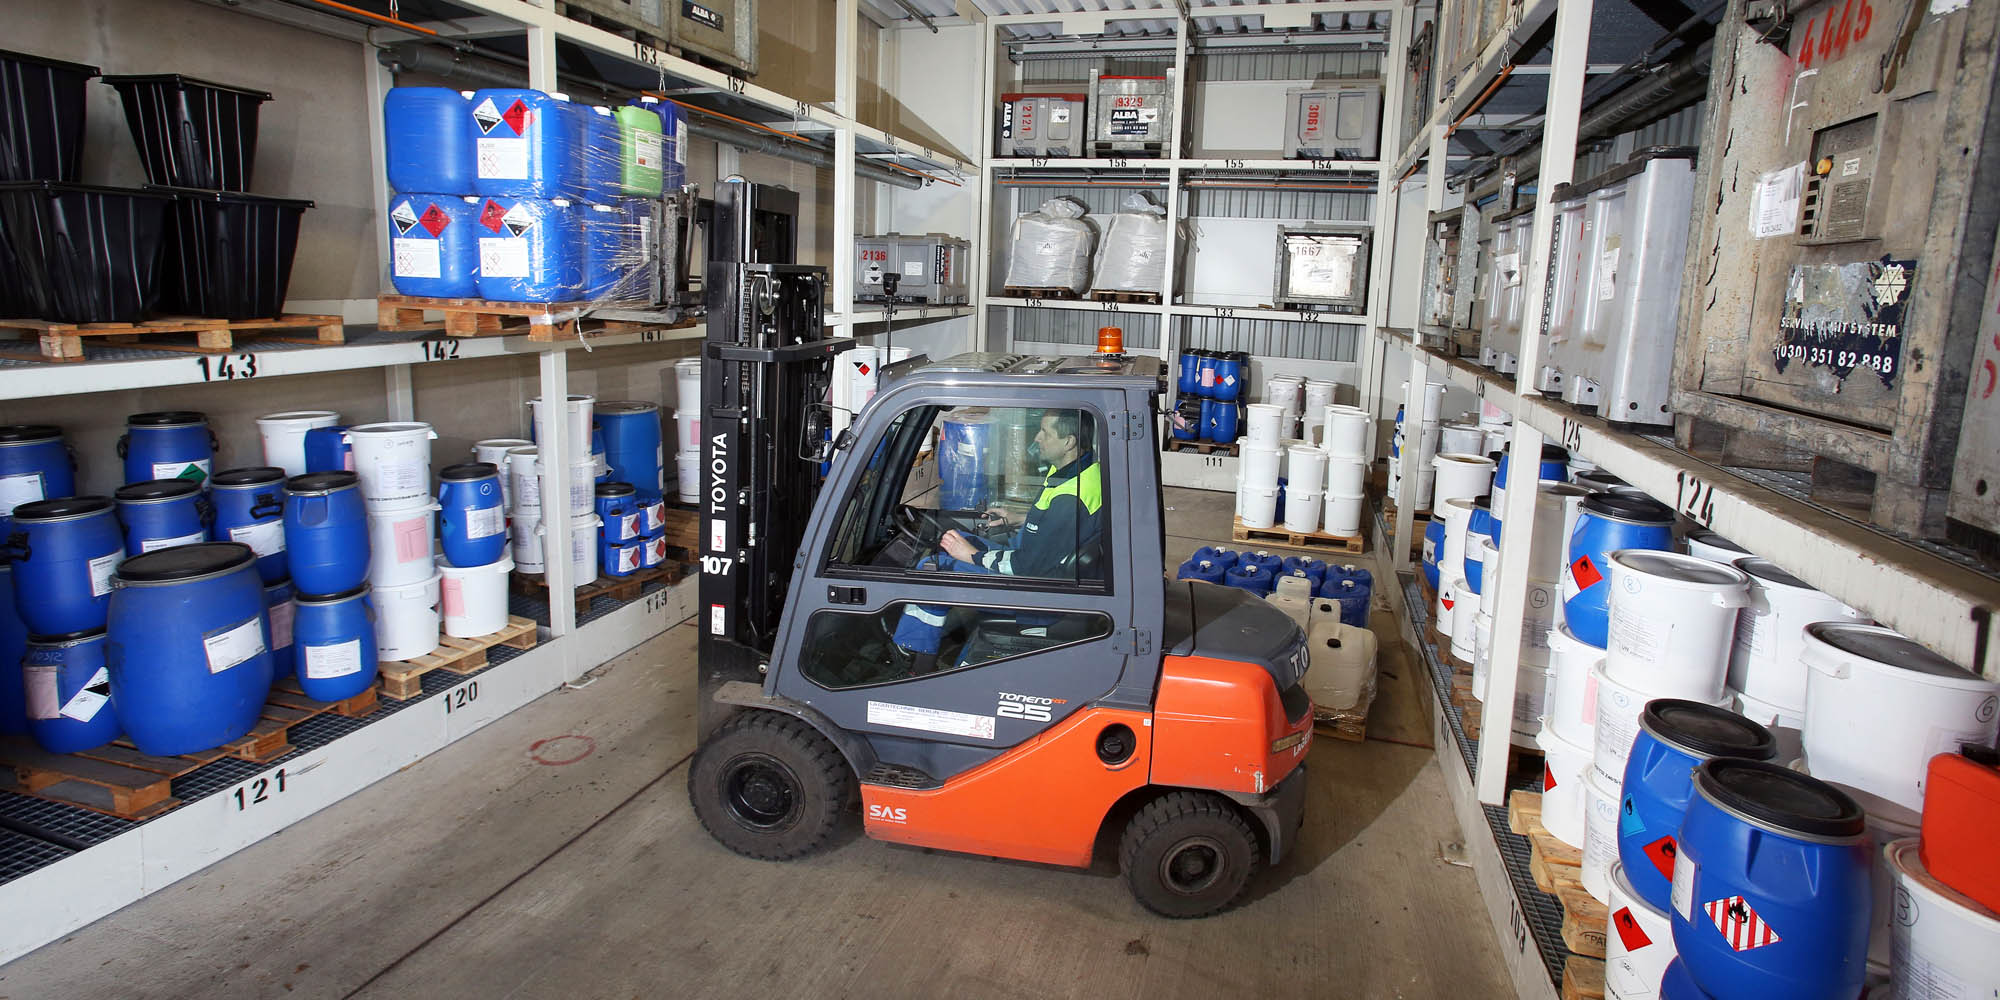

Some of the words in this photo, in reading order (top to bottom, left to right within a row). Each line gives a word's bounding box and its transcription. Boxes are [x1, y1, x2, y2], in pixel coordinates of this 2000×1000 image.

[633, 43, 657, 64] 163
[727, 75, 745, 94] 162
[1002, 102, 1012, 128] ALBA
[1022, 104, 1033, 132] 2121
[1112, 111, 1138, 120] ALBA
[1306, 104, 1320, 132] 3061
[1031, 158, 1048, 168] 157
[1109, 159, 1127, 168] 156
[1225, 159, 1244, 169] 155
[1311, 159, 1332, 170] 154
[861, 249, 887, 261] 2136
[1295, 245, 1322, 257] 1667
[1102, 302, 1119, 312] 134
[1214, 307, 1234, 318] 133
[1299, 311, 1319, 323] 132
[641, 330, 661, 343] 141
[421, 340, 460, 361] 142
[1776, 344, 1807, 363] (030)
[1811, 347, 1833, 364] 351
[1838, 351, 1857, 368] 82
[1861, 353, 1893, 374] 888
[197, 353, 257, 381] 143
[1562, 417, 1583, 453] 125
[1205, 456, 1223, 467] 111
[711, 432, 728, 514] TOYOTA
[1677, 471, 1714, 530] 124
[700, 555, 733, 576] 107
[444, 681, 478, 714] 120
[996, 700, 1052, 722] 25
[233, 768, 287, 811] 121
[869, 804, 907, 820] SAS
